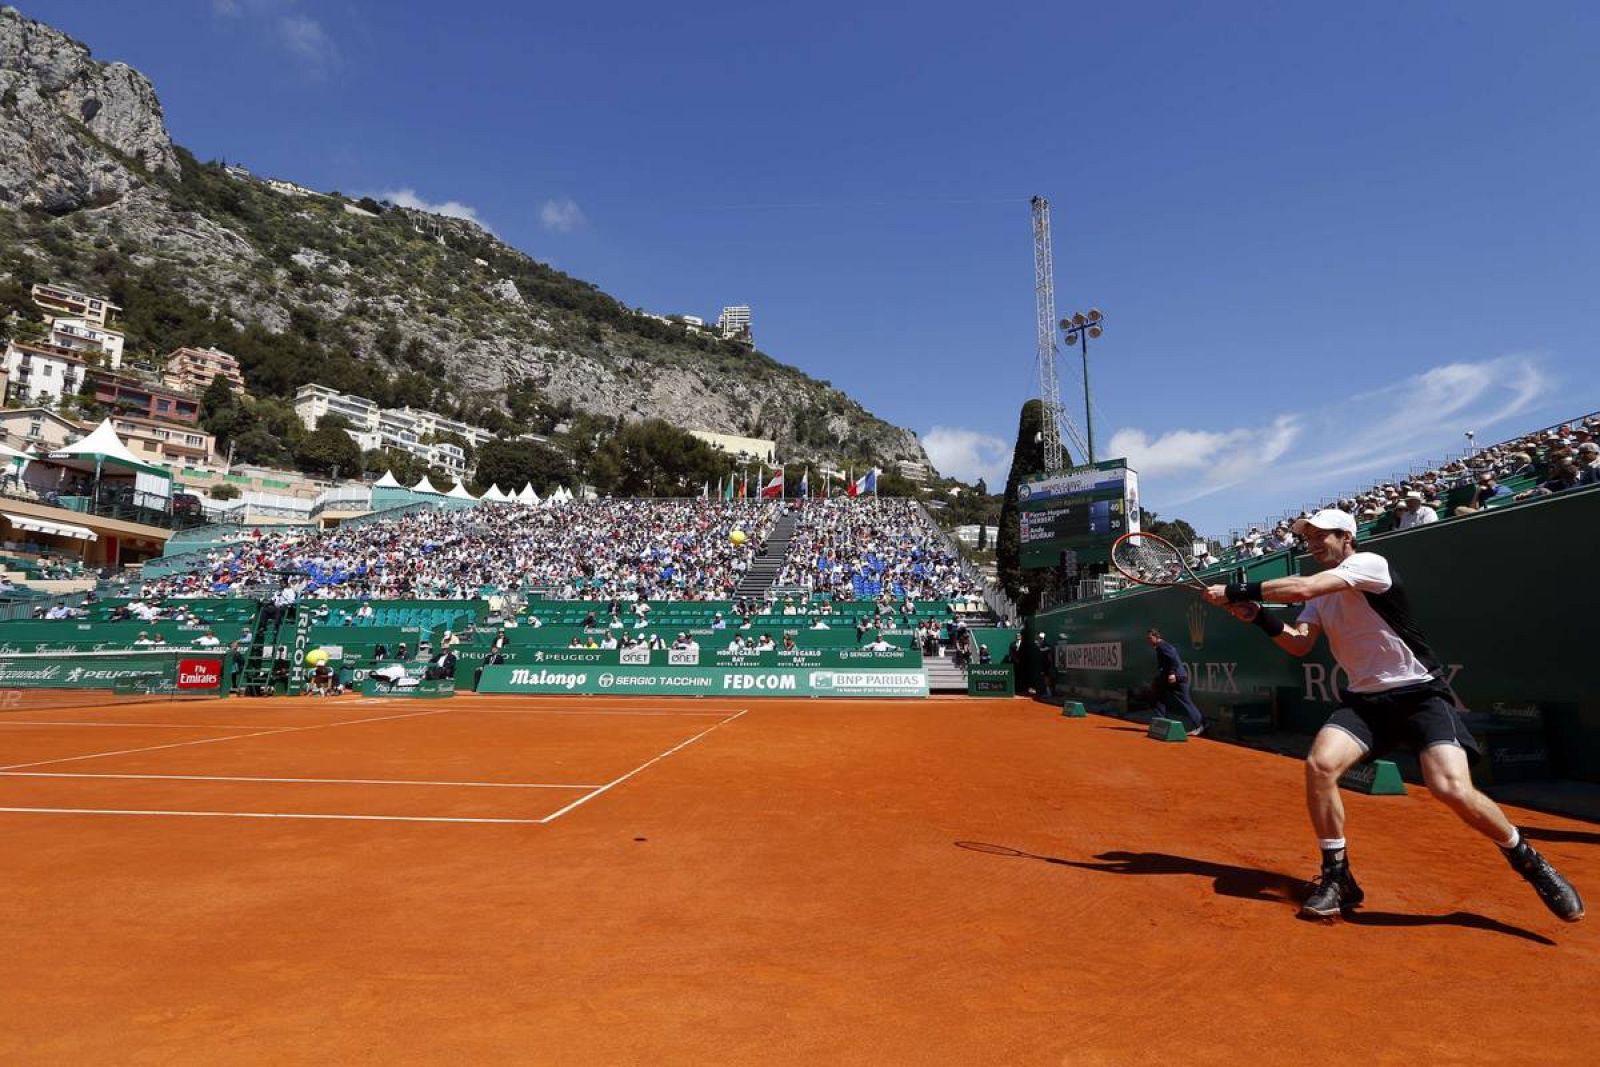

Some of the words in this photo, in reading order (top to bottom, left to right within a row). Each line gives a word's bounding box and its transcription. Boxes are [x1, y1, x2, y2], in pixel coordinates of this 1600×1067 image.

[1111, 520, 1120, 528] 30
[292, 613, 309, 681] RICOH
[874, 651, 905, 659] TACCHINI
[1083, 645, 1118, 667] PARIBAS
[194, 665, 207, 674] Fly
[180, 673, 218, 684] Emirates
[509, 669, 588, 690] Malongo
[615, 676, 657, 686] SERGIO
[659, 676, 713, 686] TACCHINI
[723, 674, 797, 690] FEDCOM
[836, 674, 863, 685] BNP
[866, 674, 920, 685] PARIBAS
